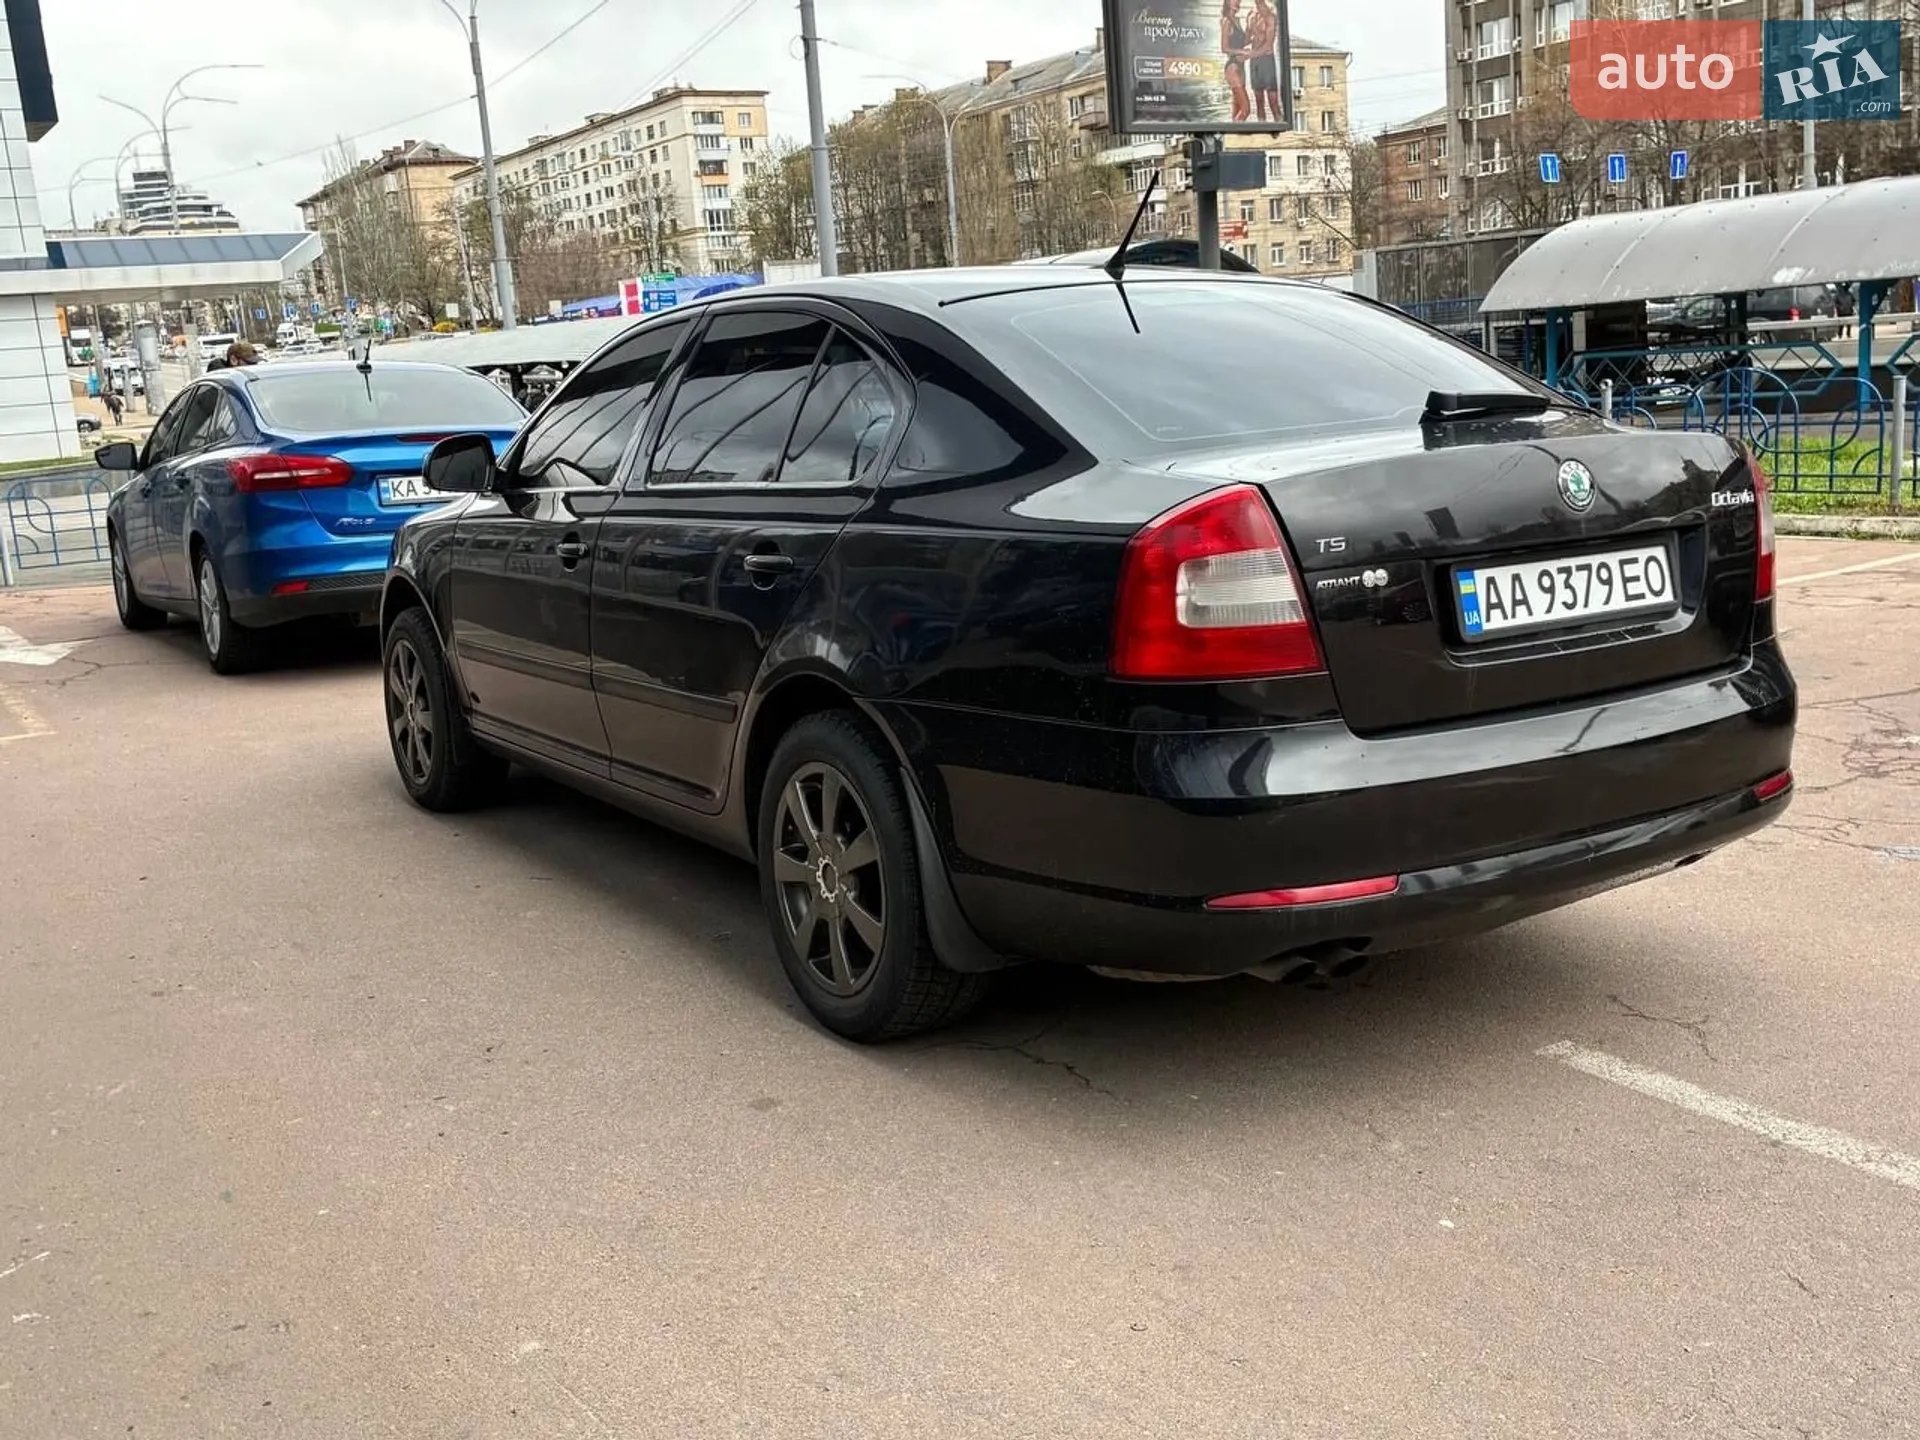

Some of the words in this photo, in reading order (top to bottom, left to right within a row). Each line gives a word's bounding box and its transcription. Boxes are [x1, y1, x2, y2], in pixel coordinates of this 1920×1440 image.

[1168, 62, 1201, 76] 4990
[391, 480, 418, 498] KA
[1711, 489, 1754, 506] Octavia
[1315, 536, 1346, 553] TS
[1484, 572, 1534, 624] AA
[1537, 560, 1614, 615] 9379
[1618, 554, 1667, 603] EO
[1464, 611, 1482, 626] UA
